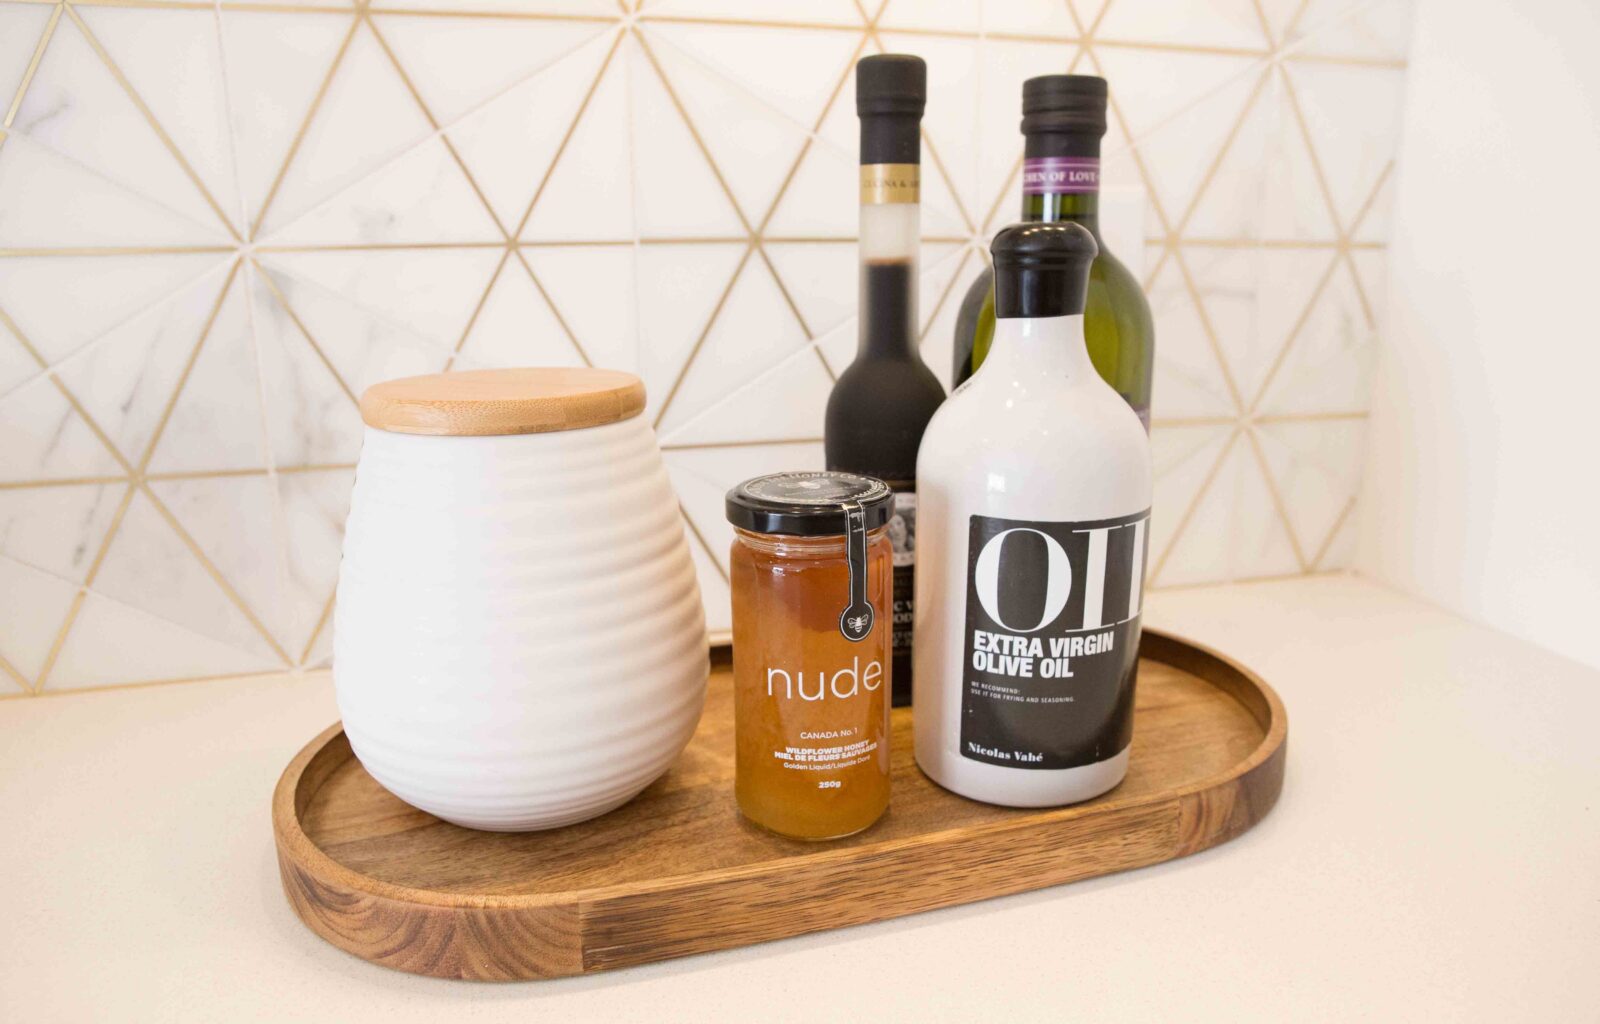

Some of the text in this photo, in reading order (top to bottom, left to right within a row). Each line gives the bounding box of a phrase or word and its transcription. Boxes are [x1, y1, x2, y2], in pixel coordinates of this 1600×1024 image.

[1048, 170, 1066, 182] OF
[1069, 170, 1096, 182] LOVE
[974, 630, 1114, 658] EXTRA VIRGIN
[972, 651, 1074, 679] OLIVE OIL
[767, 656, 882, 701] nude
[971, 688, 981, 696] USE
[990, 692, 1002, 700] FOR
[1003, 693, 1024, 702] FRYING
[800, 731, 839, 740] CANADA
[840, 729, 853, 737] No.
[774, 742, 878, 762] MIEL DE FLEURS SAUVAGES
[785, 739, 869, 755] WILDFLOWER HONEY
[968, 741, 1044, 762] Nicolas Vahé
[783, 762, 808, 770] Golden
[817, 781, 842, 789] 250g
